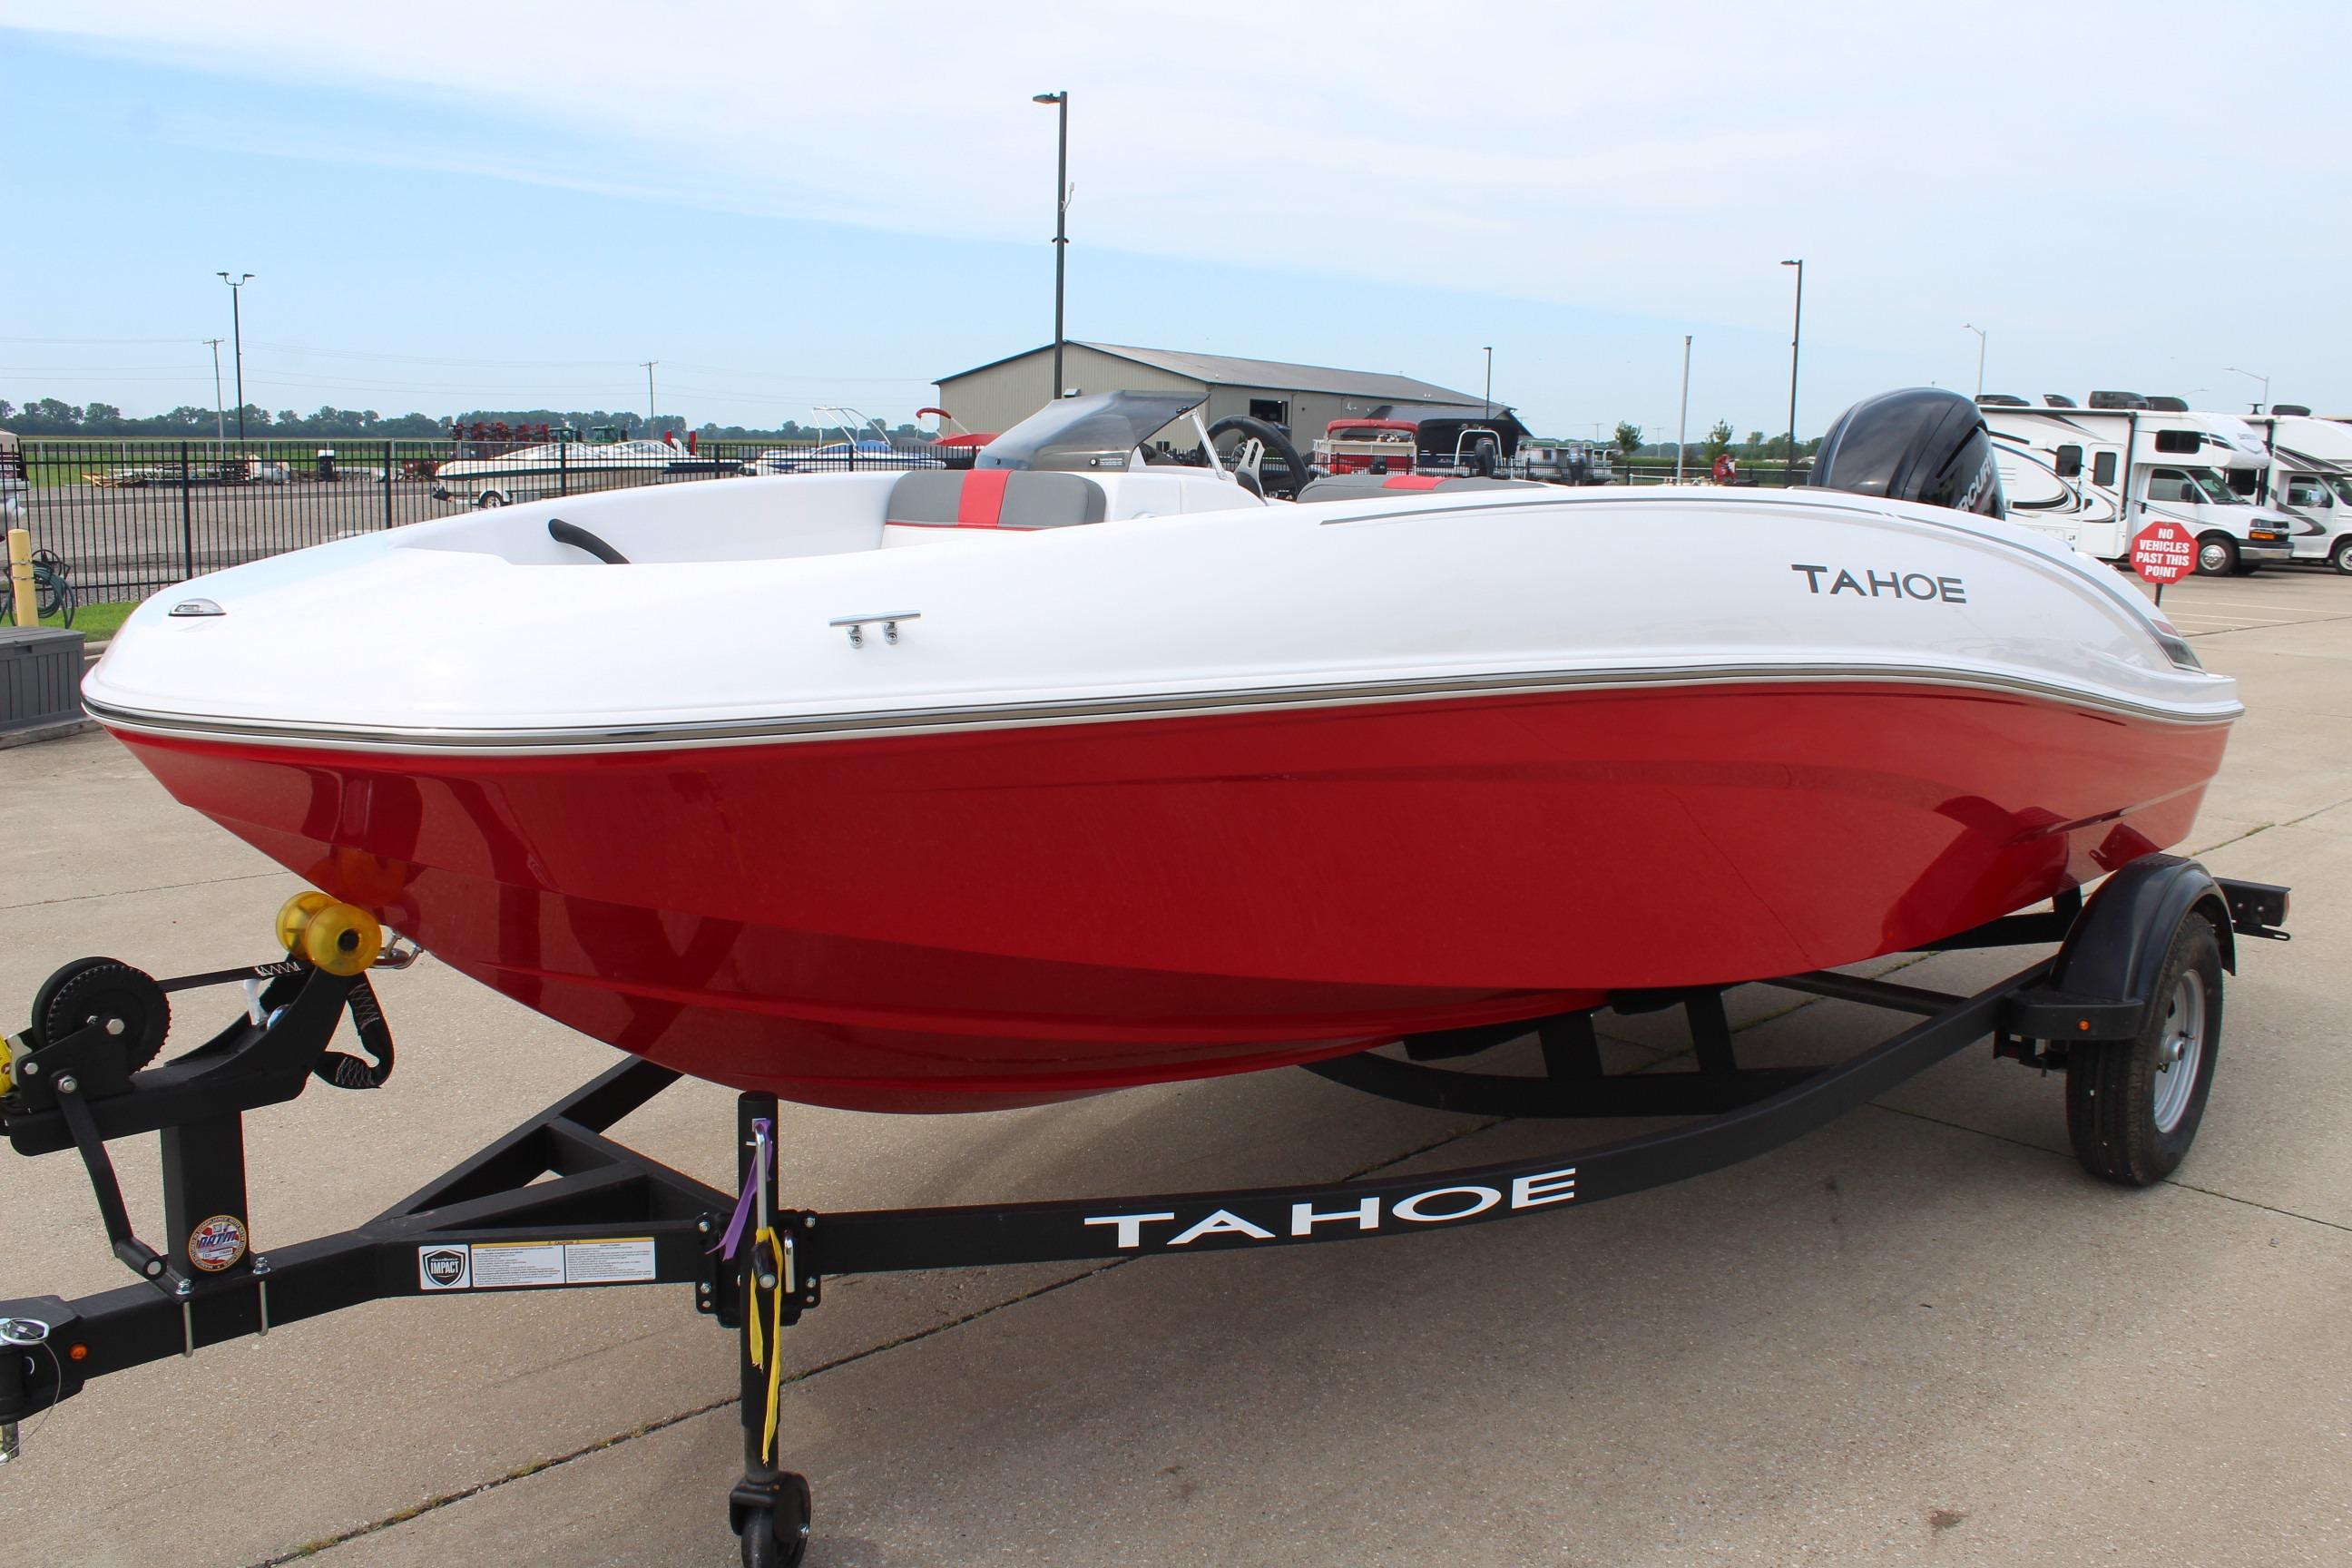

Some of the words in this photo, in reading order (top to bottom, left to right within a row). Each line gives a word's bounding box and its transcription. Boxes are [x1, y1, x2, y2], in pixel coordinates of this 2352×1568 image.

[2158, 528, 2173, 539] NO
[2140, 539, 2190, 554] VEHICLES
[2136, 552, 2163, 564] PAST
[2165, 554, 2190, 566] THIS
[2145, 565, 2178, 577] POINT
[1791, 564, 1967, 604] TAHOE
[1083, 1167, 1577, 1249] TAHOE
[431, 1261, 459, 1274] IMPACT
